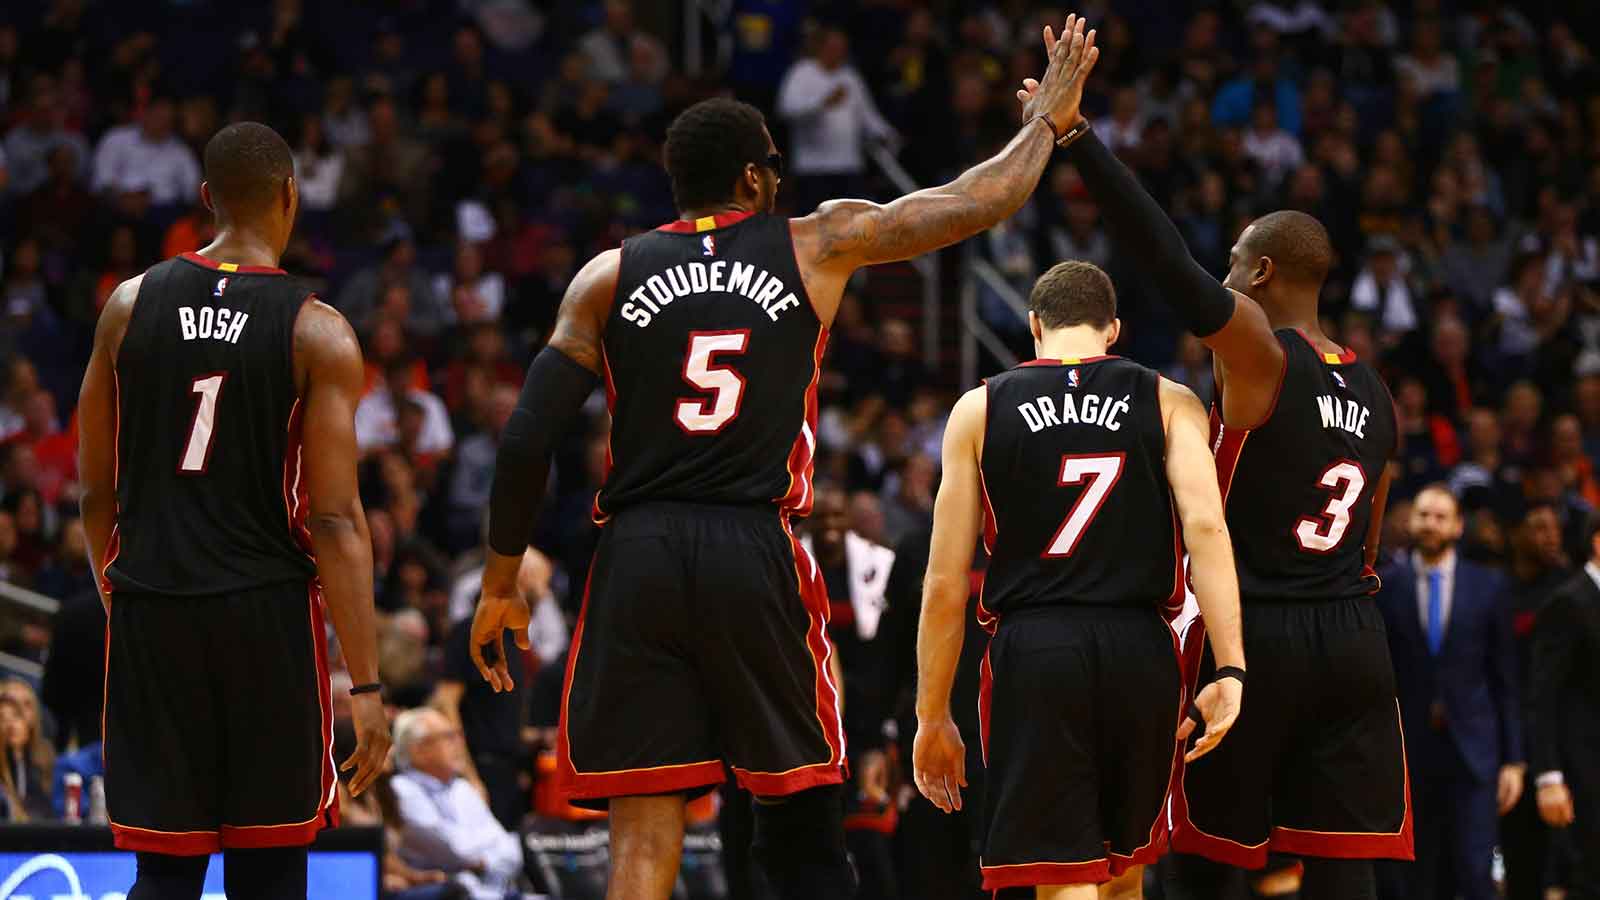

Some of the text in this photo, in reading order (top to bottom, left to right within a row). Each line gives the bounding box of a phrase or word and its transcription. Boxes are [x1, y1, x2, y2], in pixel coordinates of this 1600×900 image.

[178, 306, 249, 345] BOSH
[620, 259, 800, 328] STOUDEMIRE
[674, 328, 751, 436] 5
[1017, 394, 1130, 433] DRAGIĆ
[1316, 395, 1370, 440] WADE
[179, 371, 227, 475] 1
[1041, 452, 1127, 558] 7
[1293, 459, 1367, 553] 3
